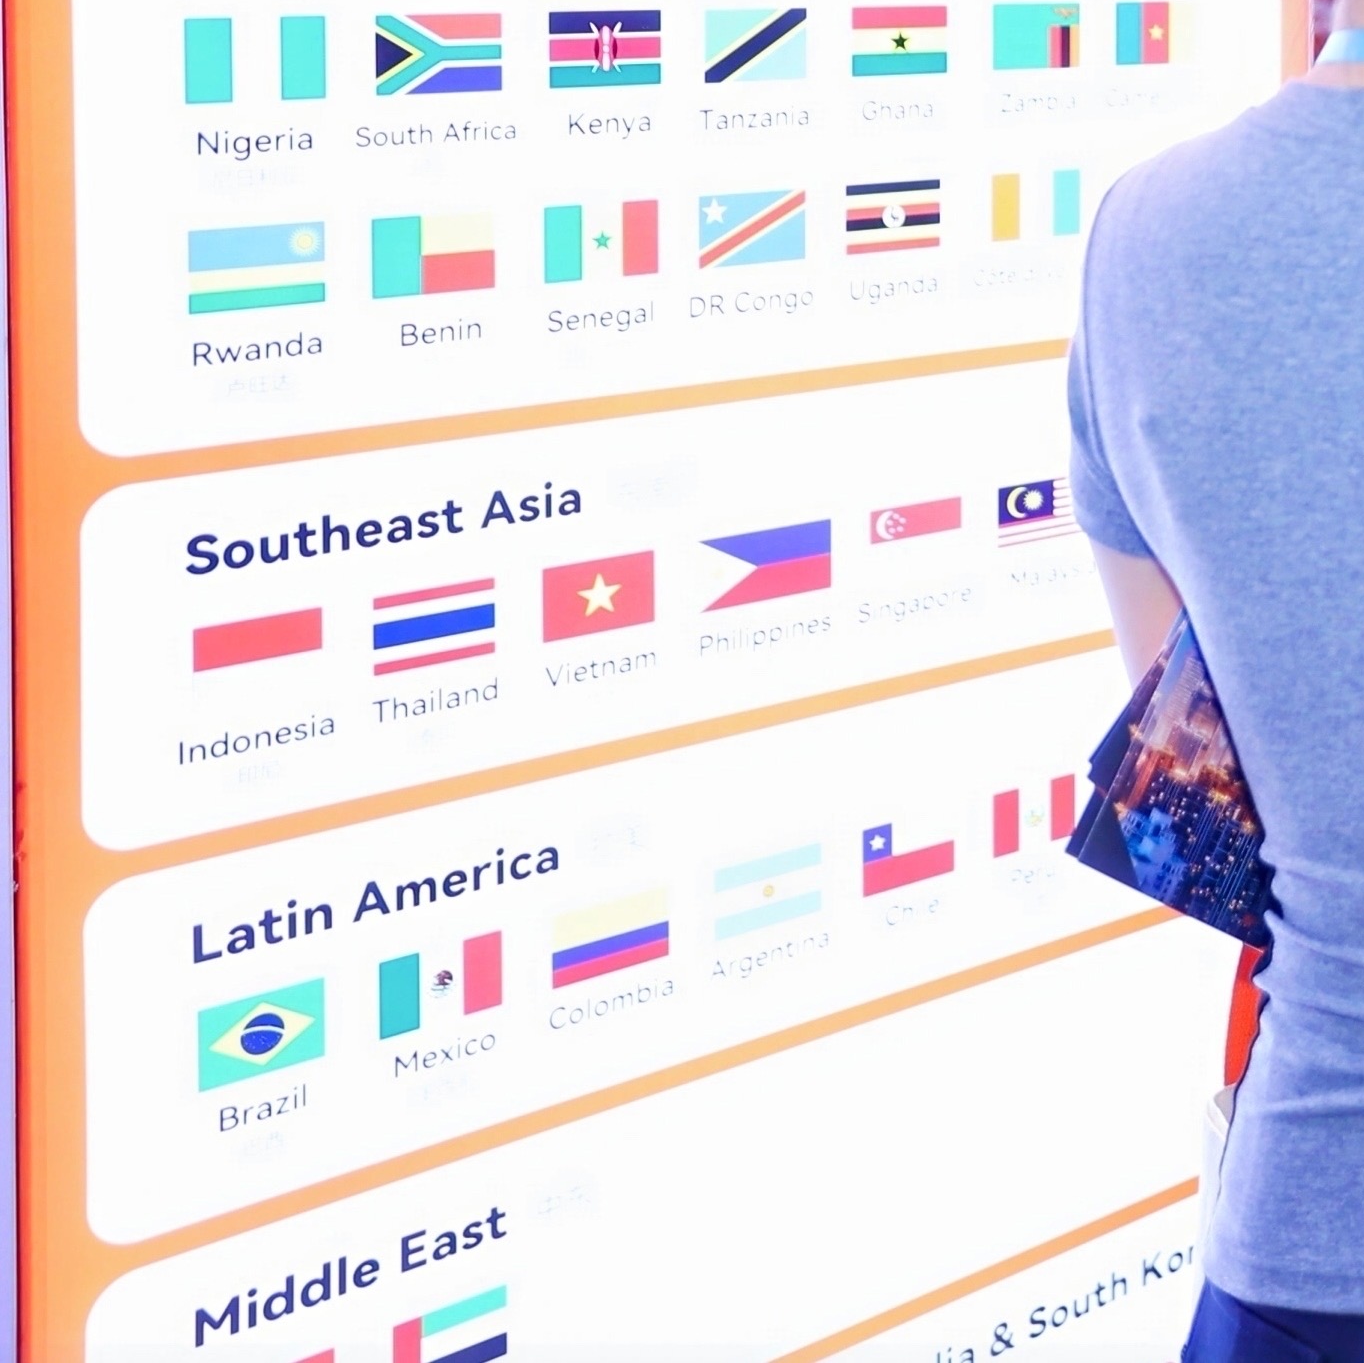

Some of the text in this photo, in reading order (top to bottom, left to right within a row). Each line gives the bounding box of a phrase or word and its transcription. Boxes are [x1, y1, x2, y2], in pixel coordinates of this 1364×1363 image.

[699, 105, 810, 132] Tanzania
[861, 99, 935, 121] Ghana
[1001, 93, 1076, 113] Zamba
[196, 128, 314, 161] Nigeria
[355, 119, 517, 148] South Africa
[567, 111, 653, 139] Kenya
[689, 283, 815, 319] DR Congo
[849, 271, 939, 306] Uganda
[400, 317, 483, 348] Benin
[547, 301, 655, 334] Senegal
[192, 331, 324, 367] Rwanda
[186, 499, 464, 575] Southeast
[480, 481, 583, 528] Asia
[698, 612, 833, 658] Philippines
[545, 648, 658, 688] Vietnam
[372, 677, 500, 724] Thailand
[178, 713, 336, 766] Indonesia
[192, 846, 560, 964] Latin America
[711, 931, 830, 981] Argentina
[549, 976, 675, 1030] Colombia
[393, 1031, 496, 1078] Mexico
[218, 1084, 308, 1132] Brazil
[195, 1206, 508, 1348] Middle East
[990, 1322, 1015, 1357] &
[1029, 1272, 1127, 1338] South
[1142, 1245, 1194, 1287] Kor
